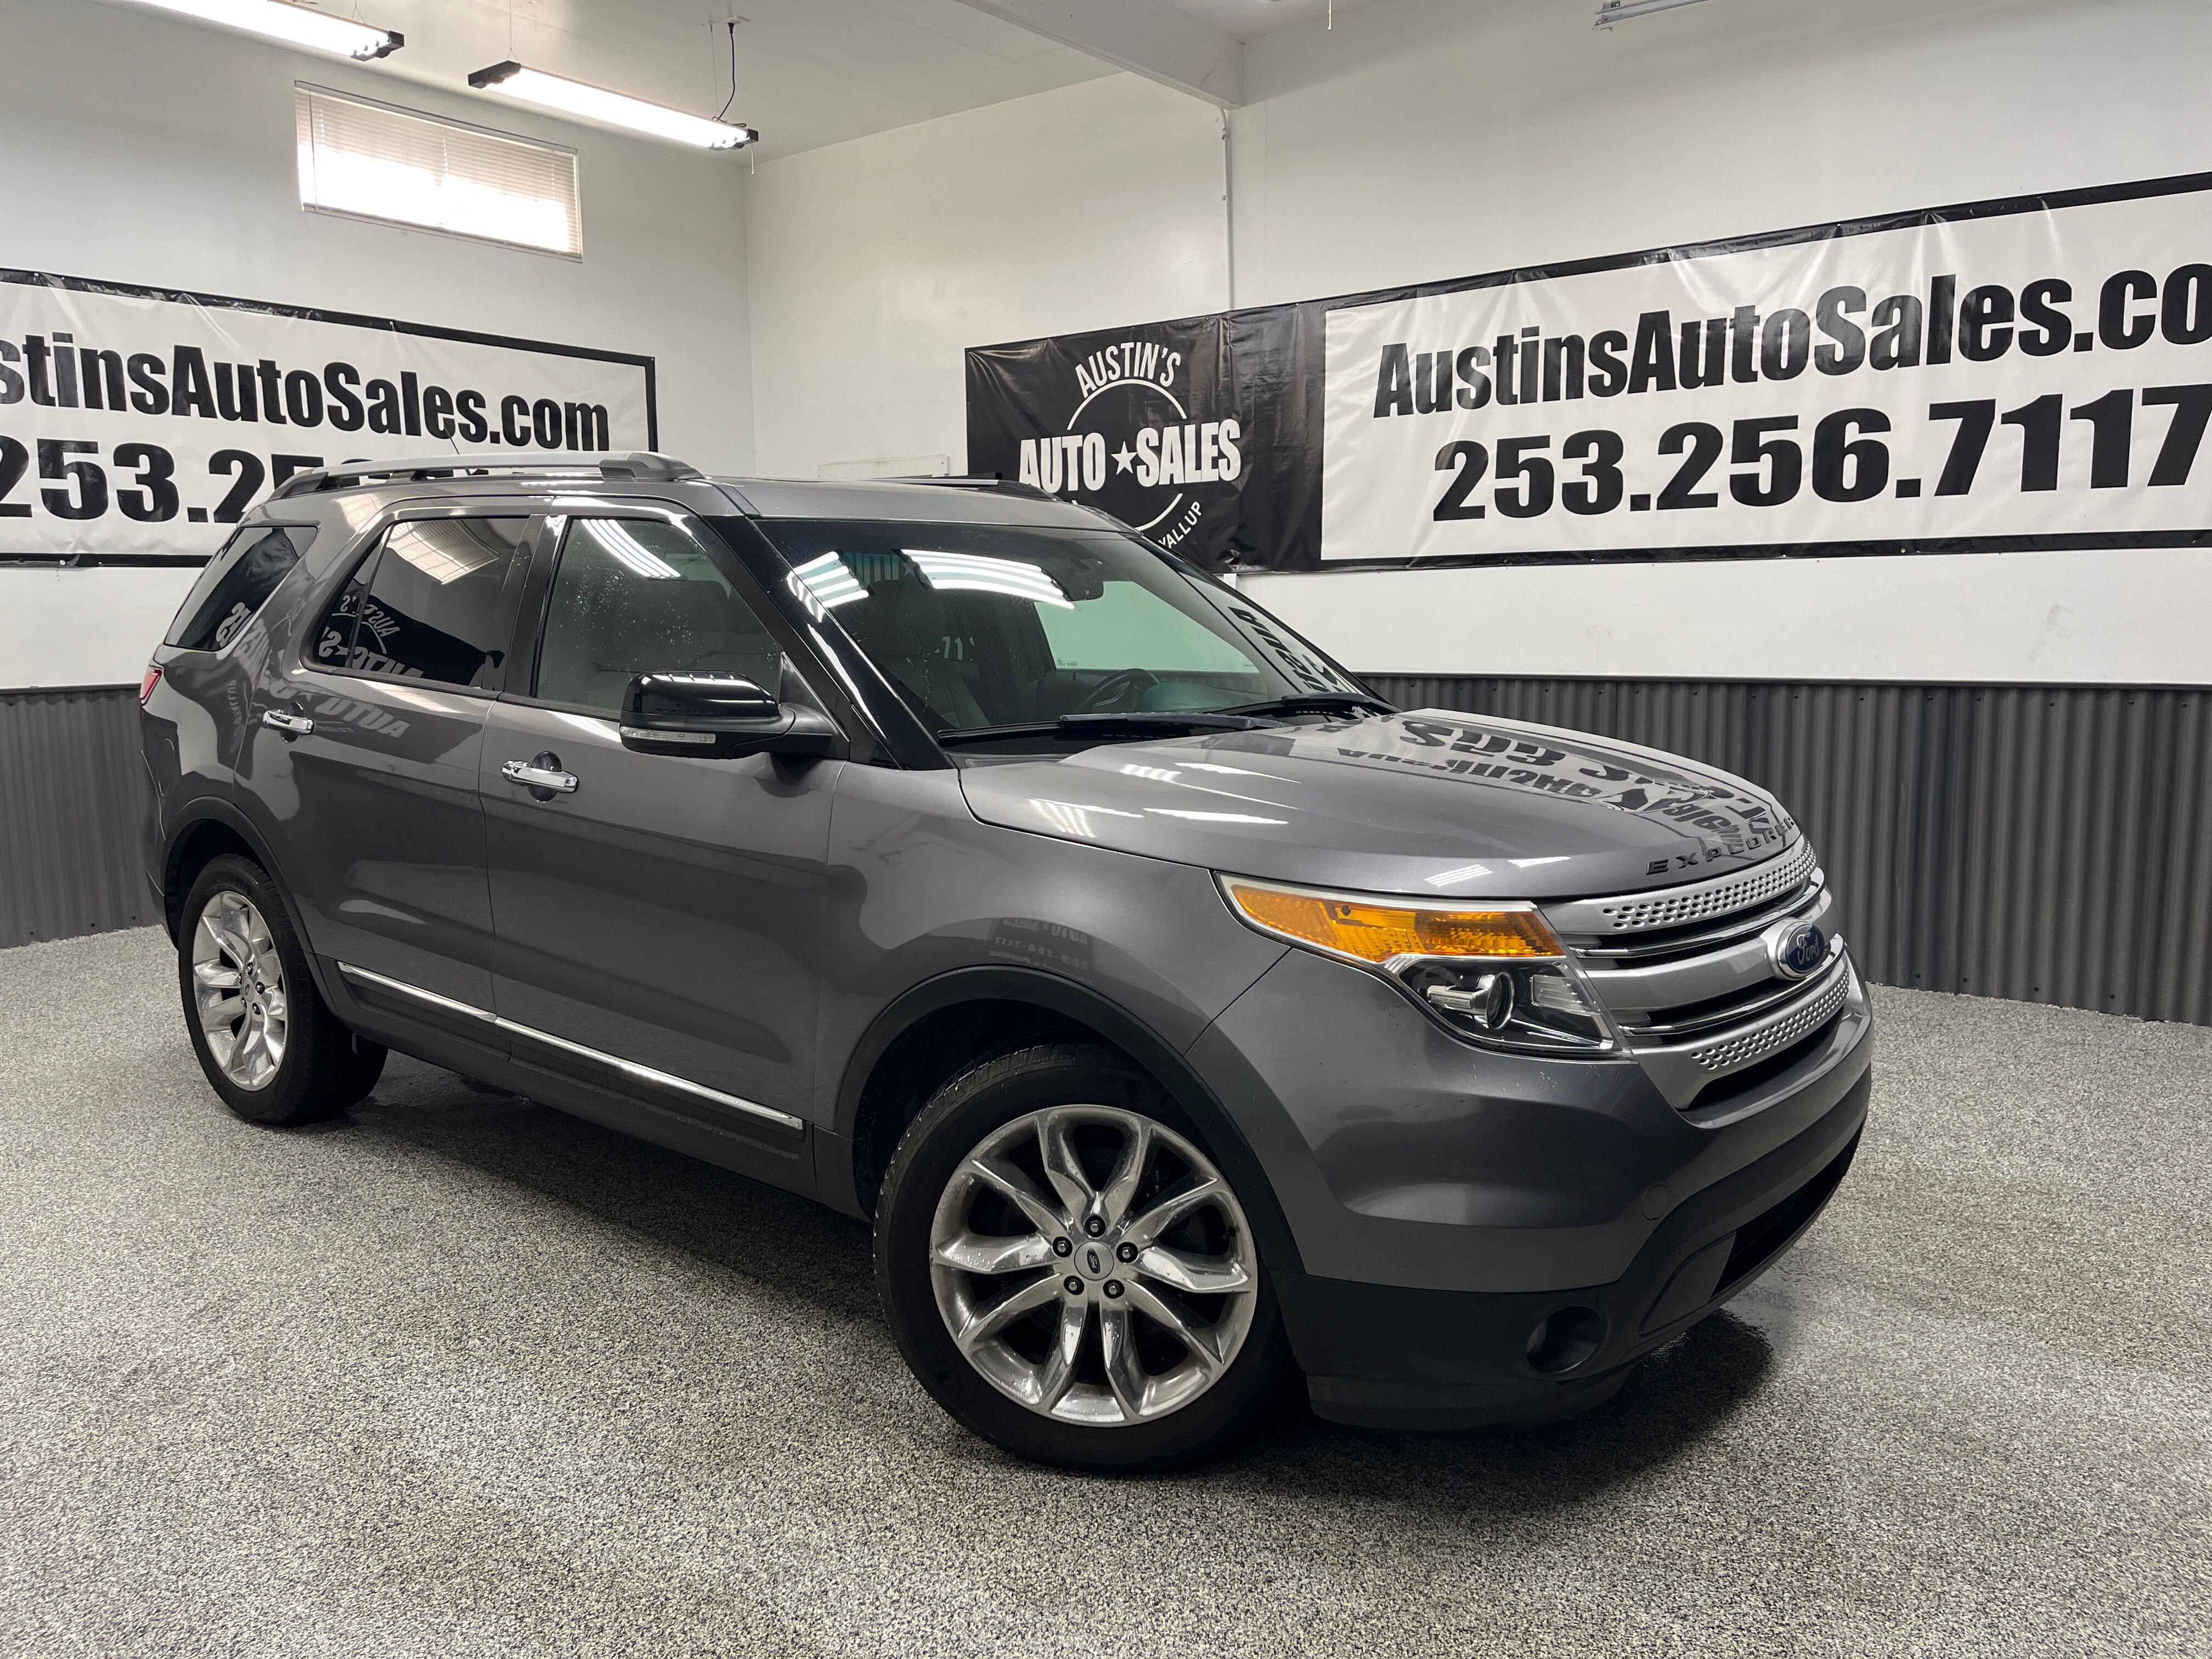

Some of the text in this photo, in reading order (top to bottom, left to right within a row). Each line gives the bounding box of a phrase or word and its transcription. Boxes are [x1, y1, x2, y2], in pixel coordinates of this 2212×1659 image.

[1075, 341, 1181, 398] AUSTIN'S
[1373, 263, 2212, 419] AustinsAutoSales.co
[0, 331, 610, 452] stinsAutoSales.com
[1019, 419, 1241, 493] AUTO SALES
[1432, 383, 2212, 522] 253.256.7117
[1646, 816, 1795, 875] EXPLORER
[1796, 932, 1820, 965] Ford
